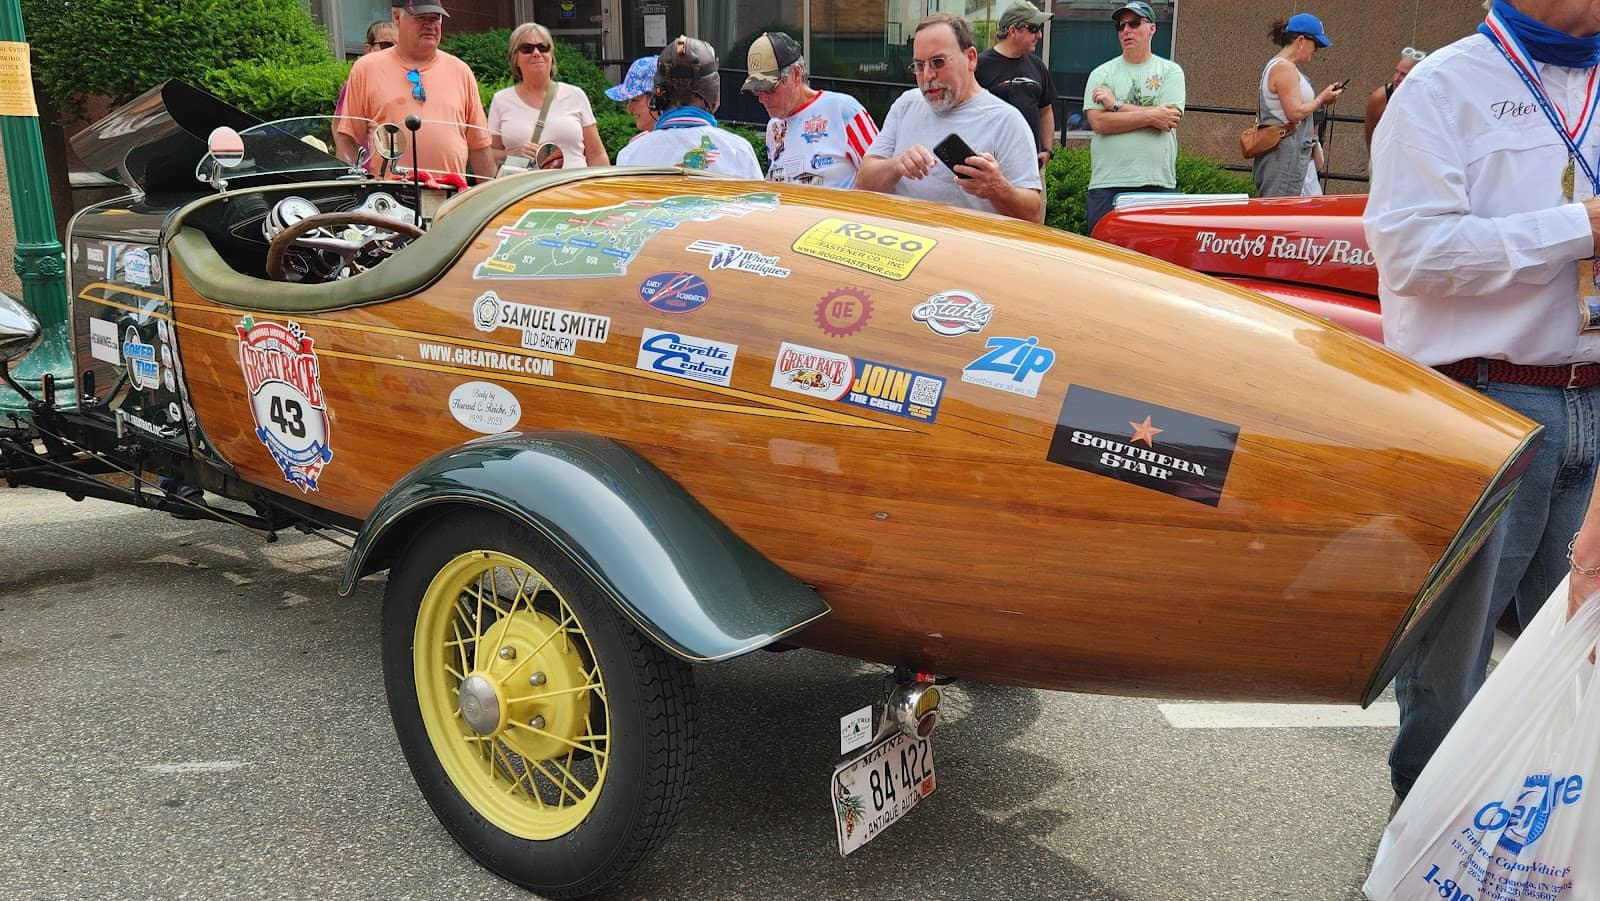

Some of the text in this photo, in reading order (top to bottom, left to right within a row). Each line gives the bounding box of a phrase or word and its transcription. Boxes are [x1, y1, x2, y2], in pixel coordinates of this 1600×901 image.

[1491, 100, 1537, 120] Peter
[742, 251, 777, 266] Wheel
[817, 242, 865, 259] FASTENER
[1268, 235, 1376, 267] Rally/Rac
[737, 259, 788, 277] Vintiques
[641, 287, 655, 295] FORD
[501, 304, 608, 340] SAMUEL SMITH
[832, 301, 855, 319] QE
[124, 342, 154, 358] COKER
[420, 343, 554, 376] WWW.GREATRACE.COM
[642, 333, 731, 361] Corvette
[965, 337, 1054, 382] Zip
[135, 360, 158, 378] TIRE
[242, 345, 321, 405] GREAT RACE
[652, 352, 730, 377] Central
[780, 349, 848, 386] GREAT RACE
[852, 363, 912, 402] JOIN
[850, 392, 867, 405] THE
[868, 397, 903, 413] CREW!
[270, 396, 306, 439] 43
[1070, 430, 1208, 477] SOUTHERN
[862, 737, 904, 768] MAINE
[868, 806, 899, 834] ANTIQUE
